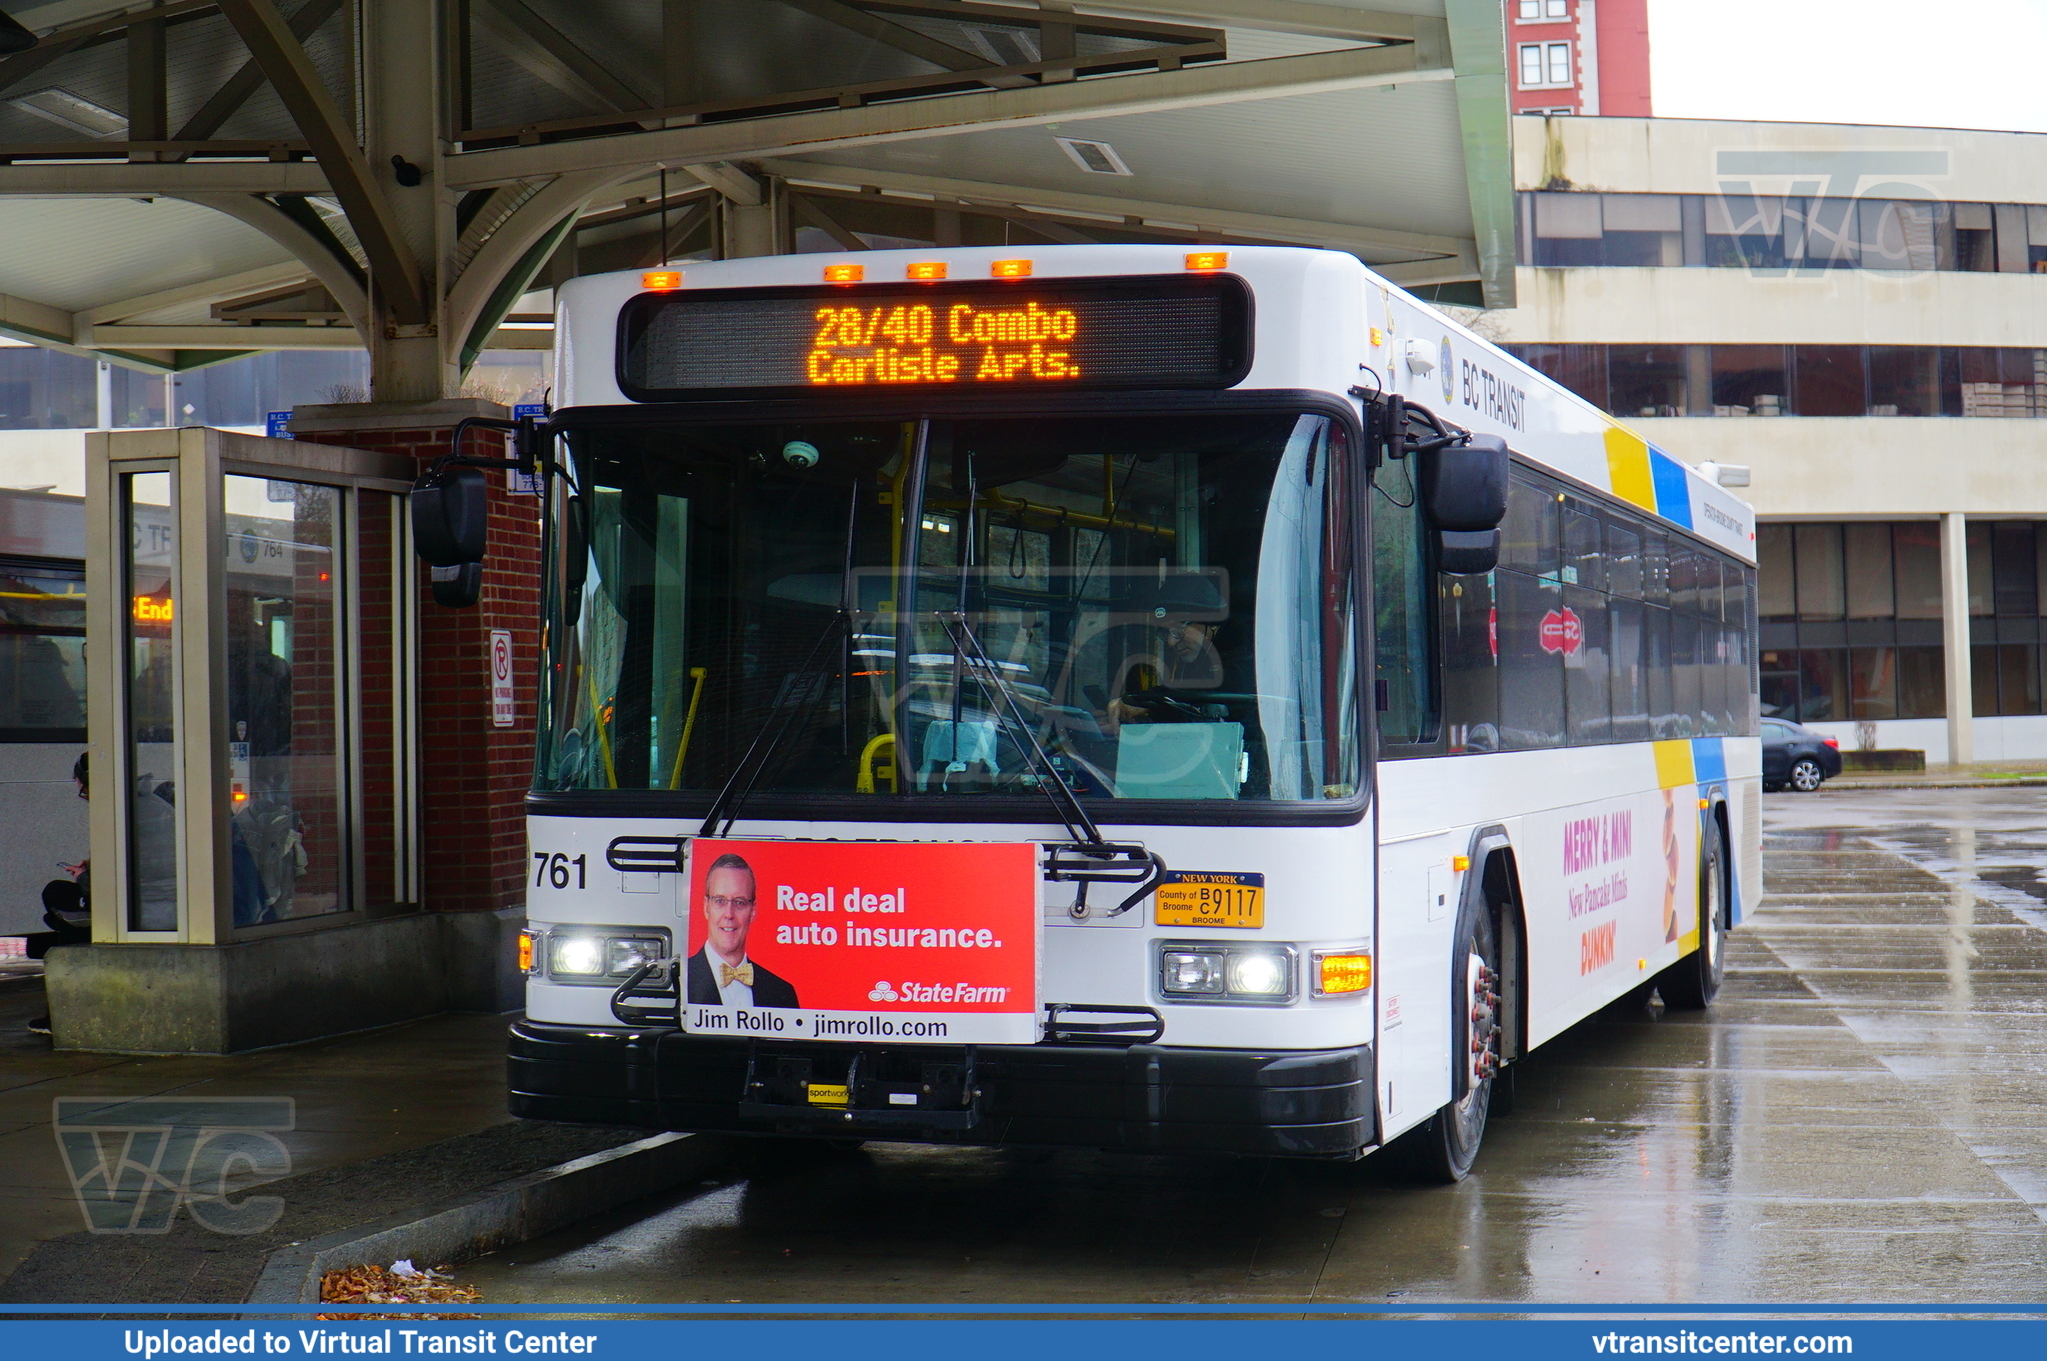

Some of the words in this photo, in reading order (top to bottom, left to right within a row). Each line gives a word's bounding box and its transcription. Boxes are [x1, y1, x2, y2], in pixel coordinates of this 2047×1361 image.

[815, 304, 933, 346] 28/40
[950, 302, 1077, 342] Combo
[808, 347, 959, 383] Carlisle
[1462, 358, 1479, 411] BC
[1481, 368, 1526, 433] TRANSIT
[263, 540, 283, 558] 764
[138, 597, 174, 621] End
[1563, 815, 1600, 877] MERRY
[1602, 813, 1609, 864] &
[1611, 808, 1632, 863] MINI
[534, 852, 586, 889] 761
[1182, 874, 1208, 883] NEW
[1209, 874, 1238, 884] YORK
[776, 885, 835, 912] Real
[843, 887, 905, 913] deal
[1159, 890, 1187, 900] County
[1188, 891, 1197, 900] of
[1163, 902, 1193, 911] Broome
[1568, 887, 1584, 921] New
[1584, 877, 1611, 914] Pancake
[776, 922, 838, 946] auto
[846, 921, 1002, 948] insurance.
[1192, 917, 1226, 925] BROOME
[694, 1009, 729, 1029] Jim
[737, 1010, 785, 1032] Rollo
[813, 1014, 948, 1037] jimrollo.com
[809, 1089, 850, 1097] sportwork
